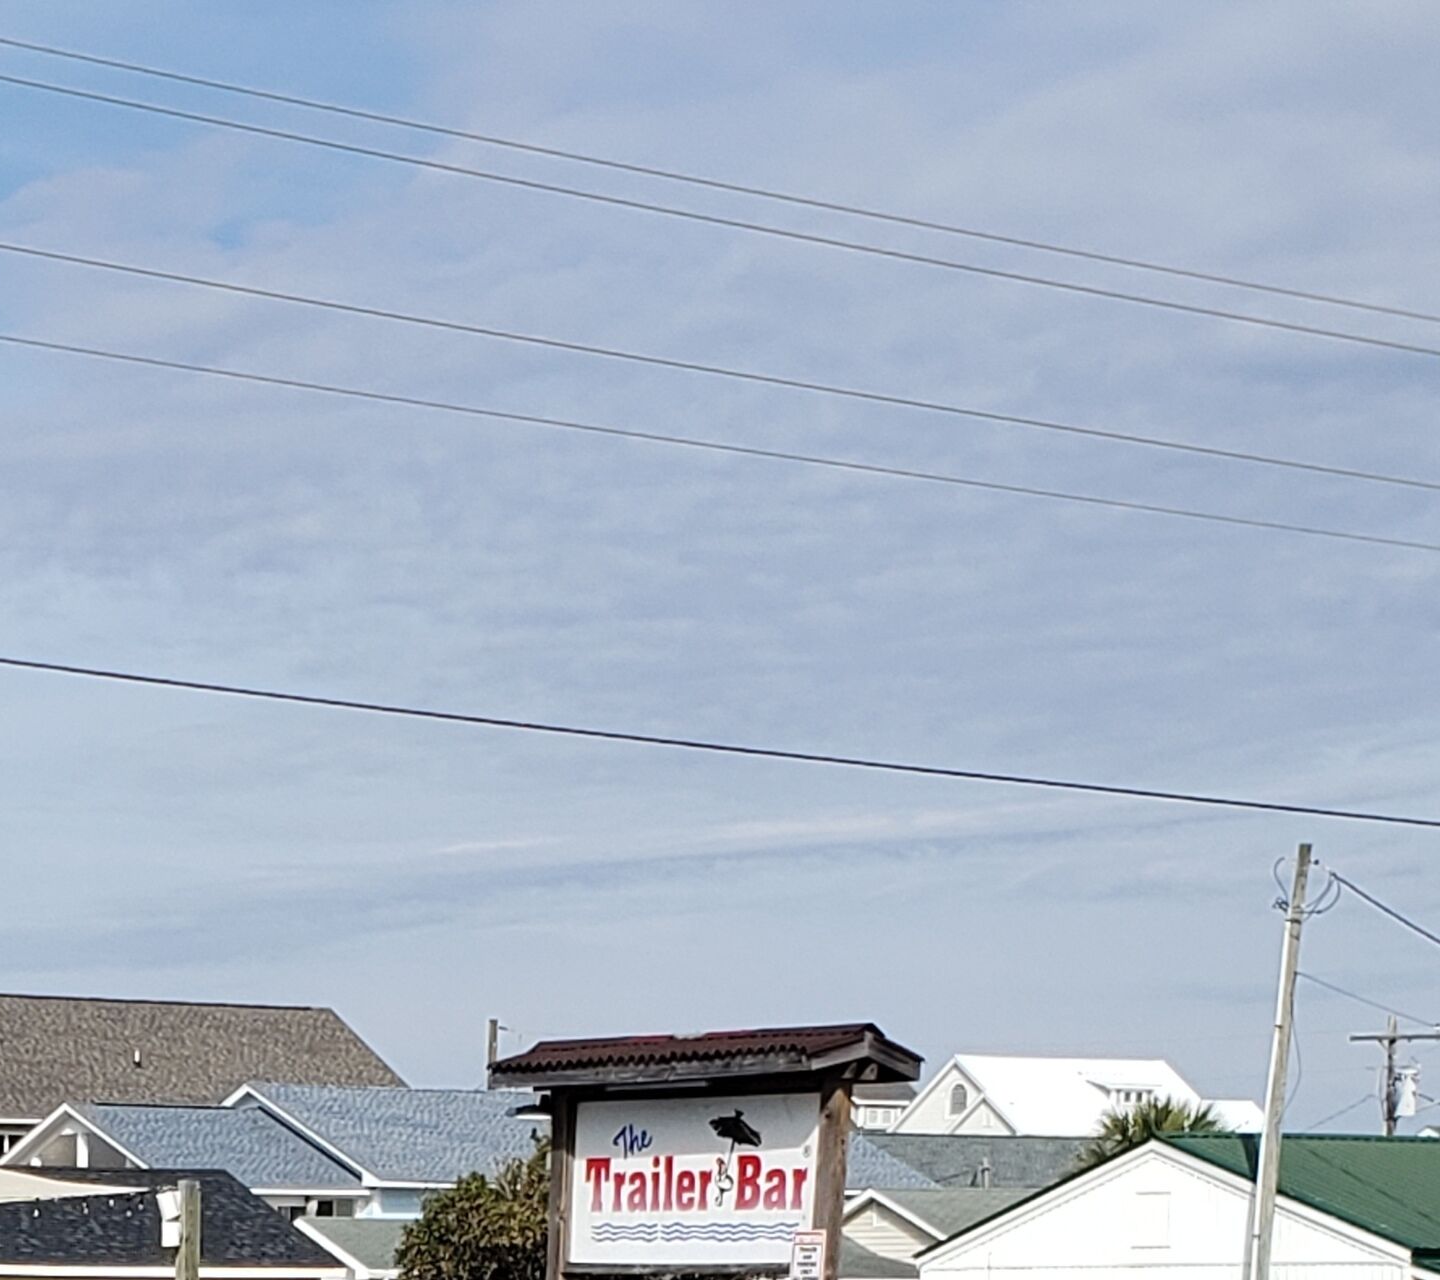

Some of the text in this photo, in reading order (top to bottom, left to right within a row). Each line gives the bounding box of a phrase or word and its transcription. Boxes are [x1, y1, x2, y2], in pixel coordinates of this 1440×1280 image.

[613, 1124, 653, 1158] The
[585, 1154, 808, 1213] Trailer Bar
